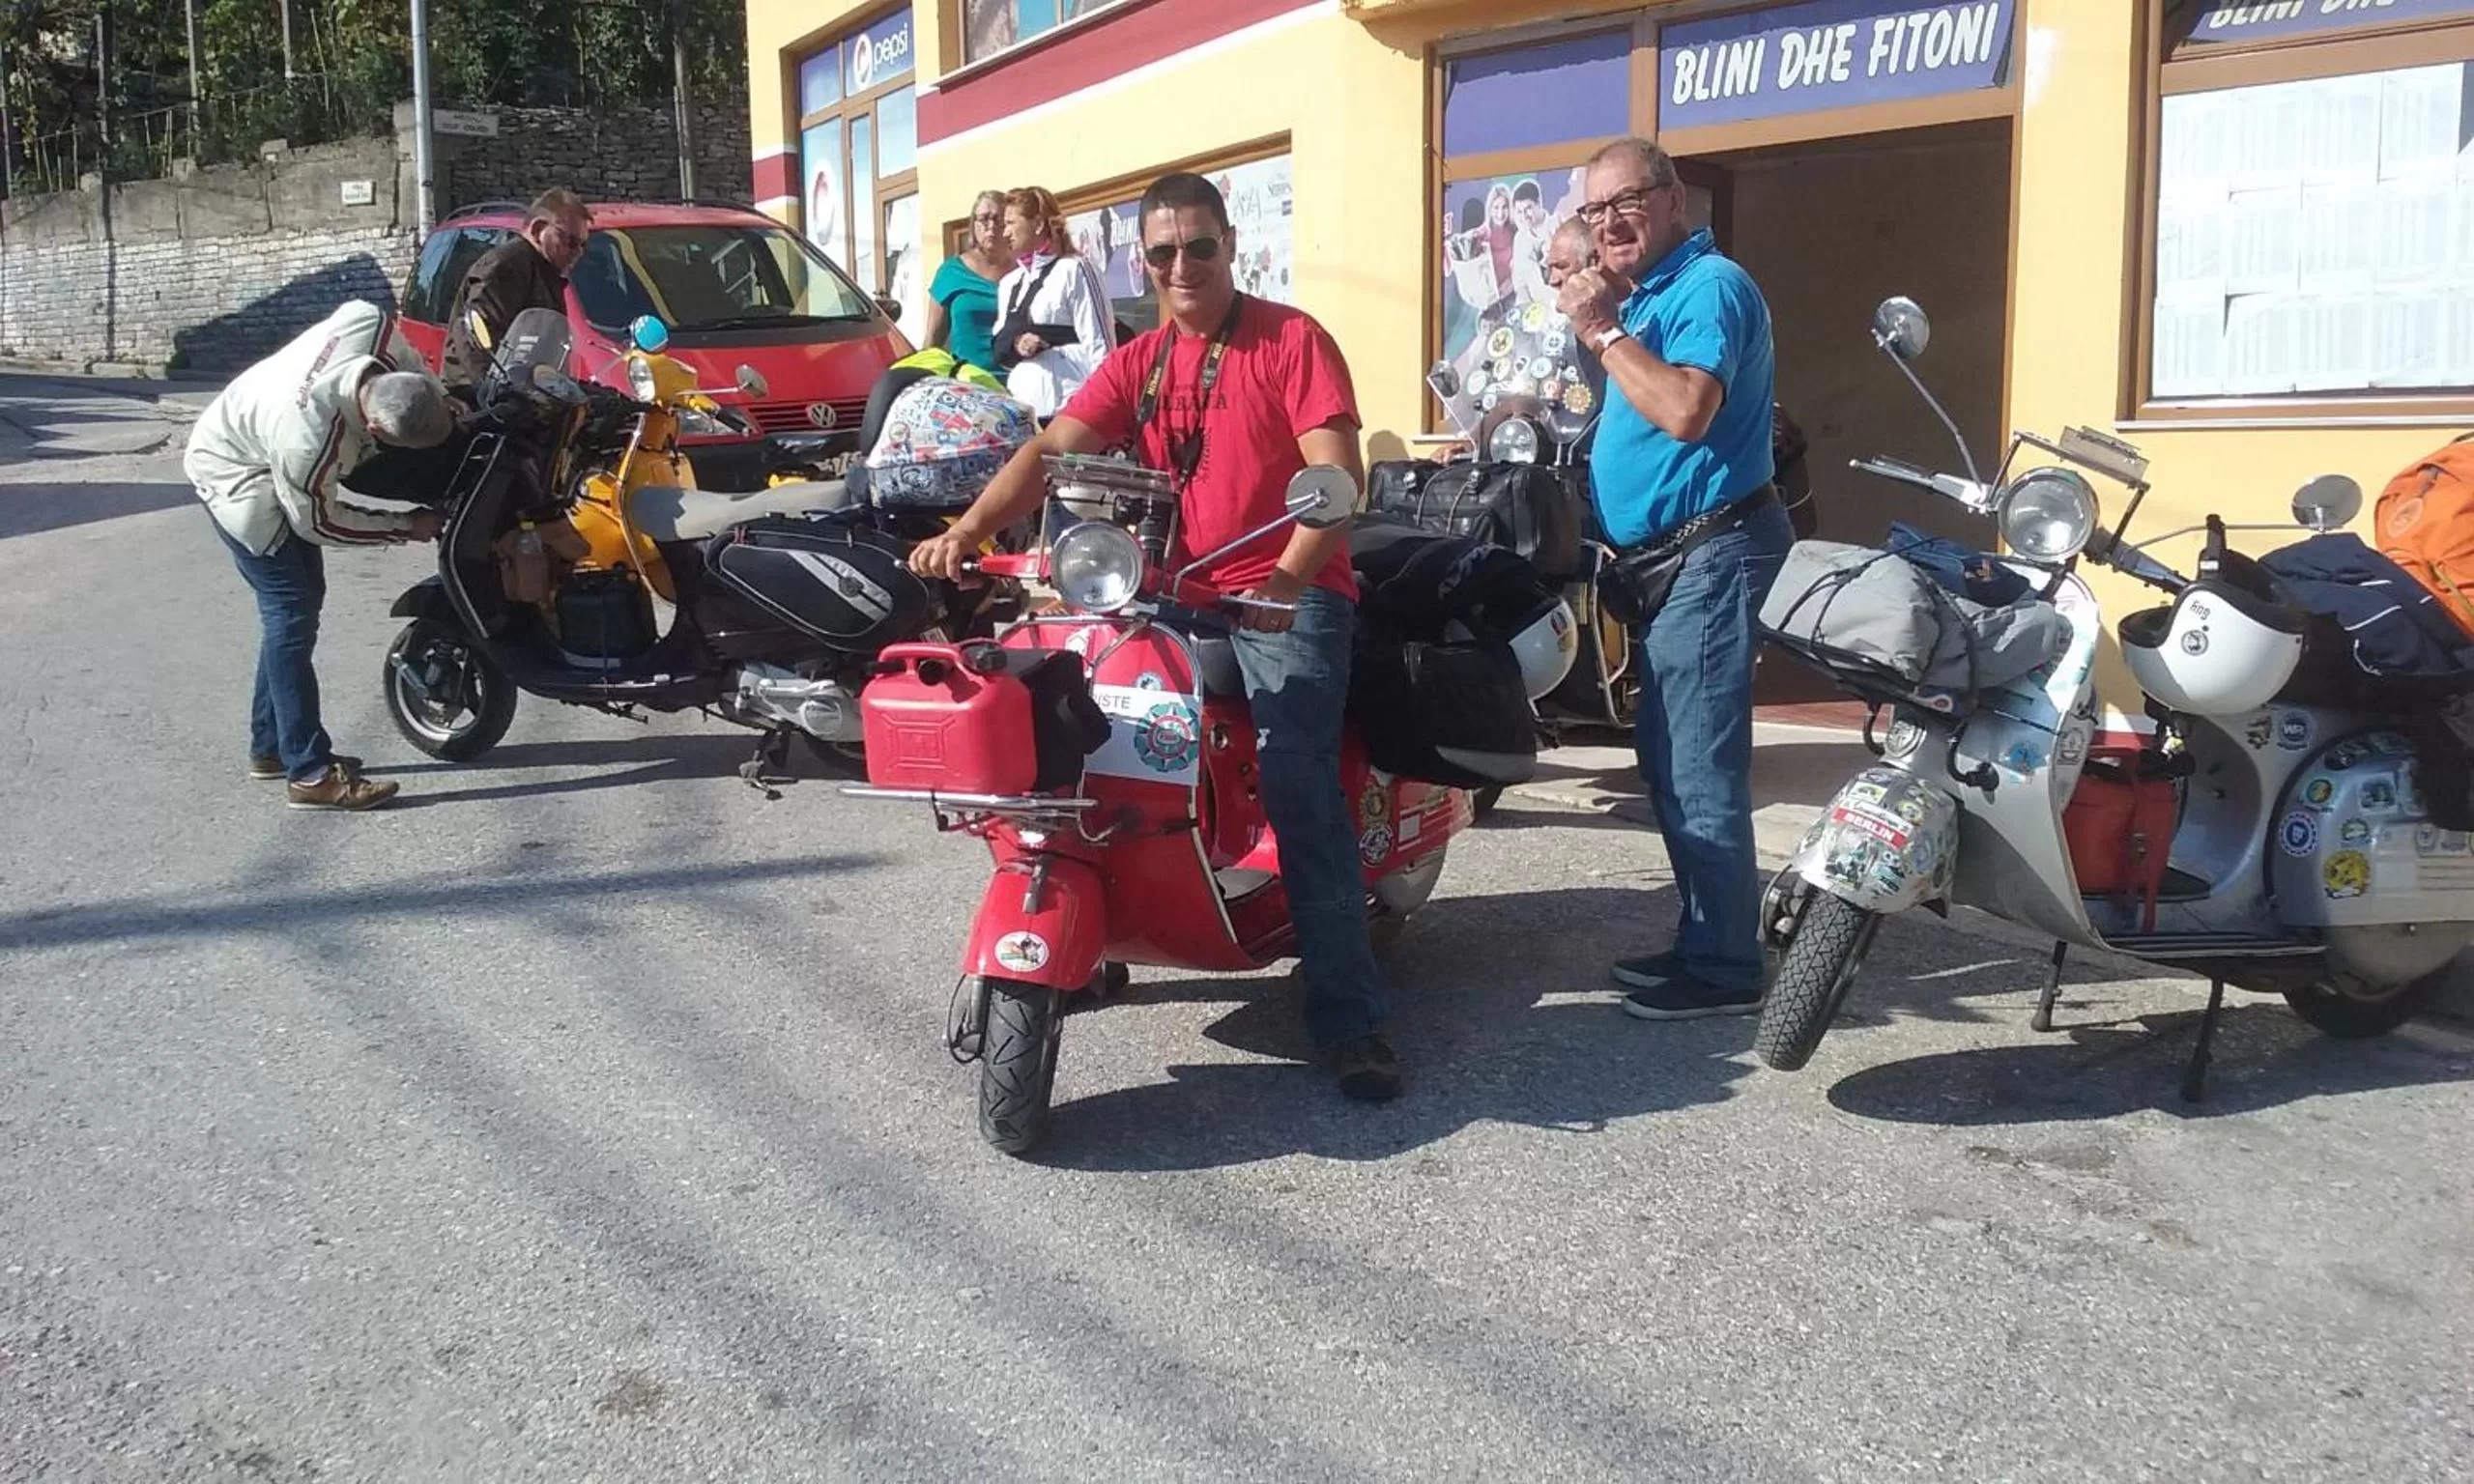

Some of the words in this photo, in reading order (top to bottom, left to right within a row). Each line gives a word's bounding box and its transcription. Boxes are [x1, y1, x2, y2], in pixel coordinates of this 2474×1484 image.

[874, 22, 908, 73] pepsi
[1672, 39, 1767, 104] BLINI
[1777, 23, 1856, 90] DHE
[1867, 2, 1999, 77] FITONI
[1844, 812, 1895, 842] BERLIN
